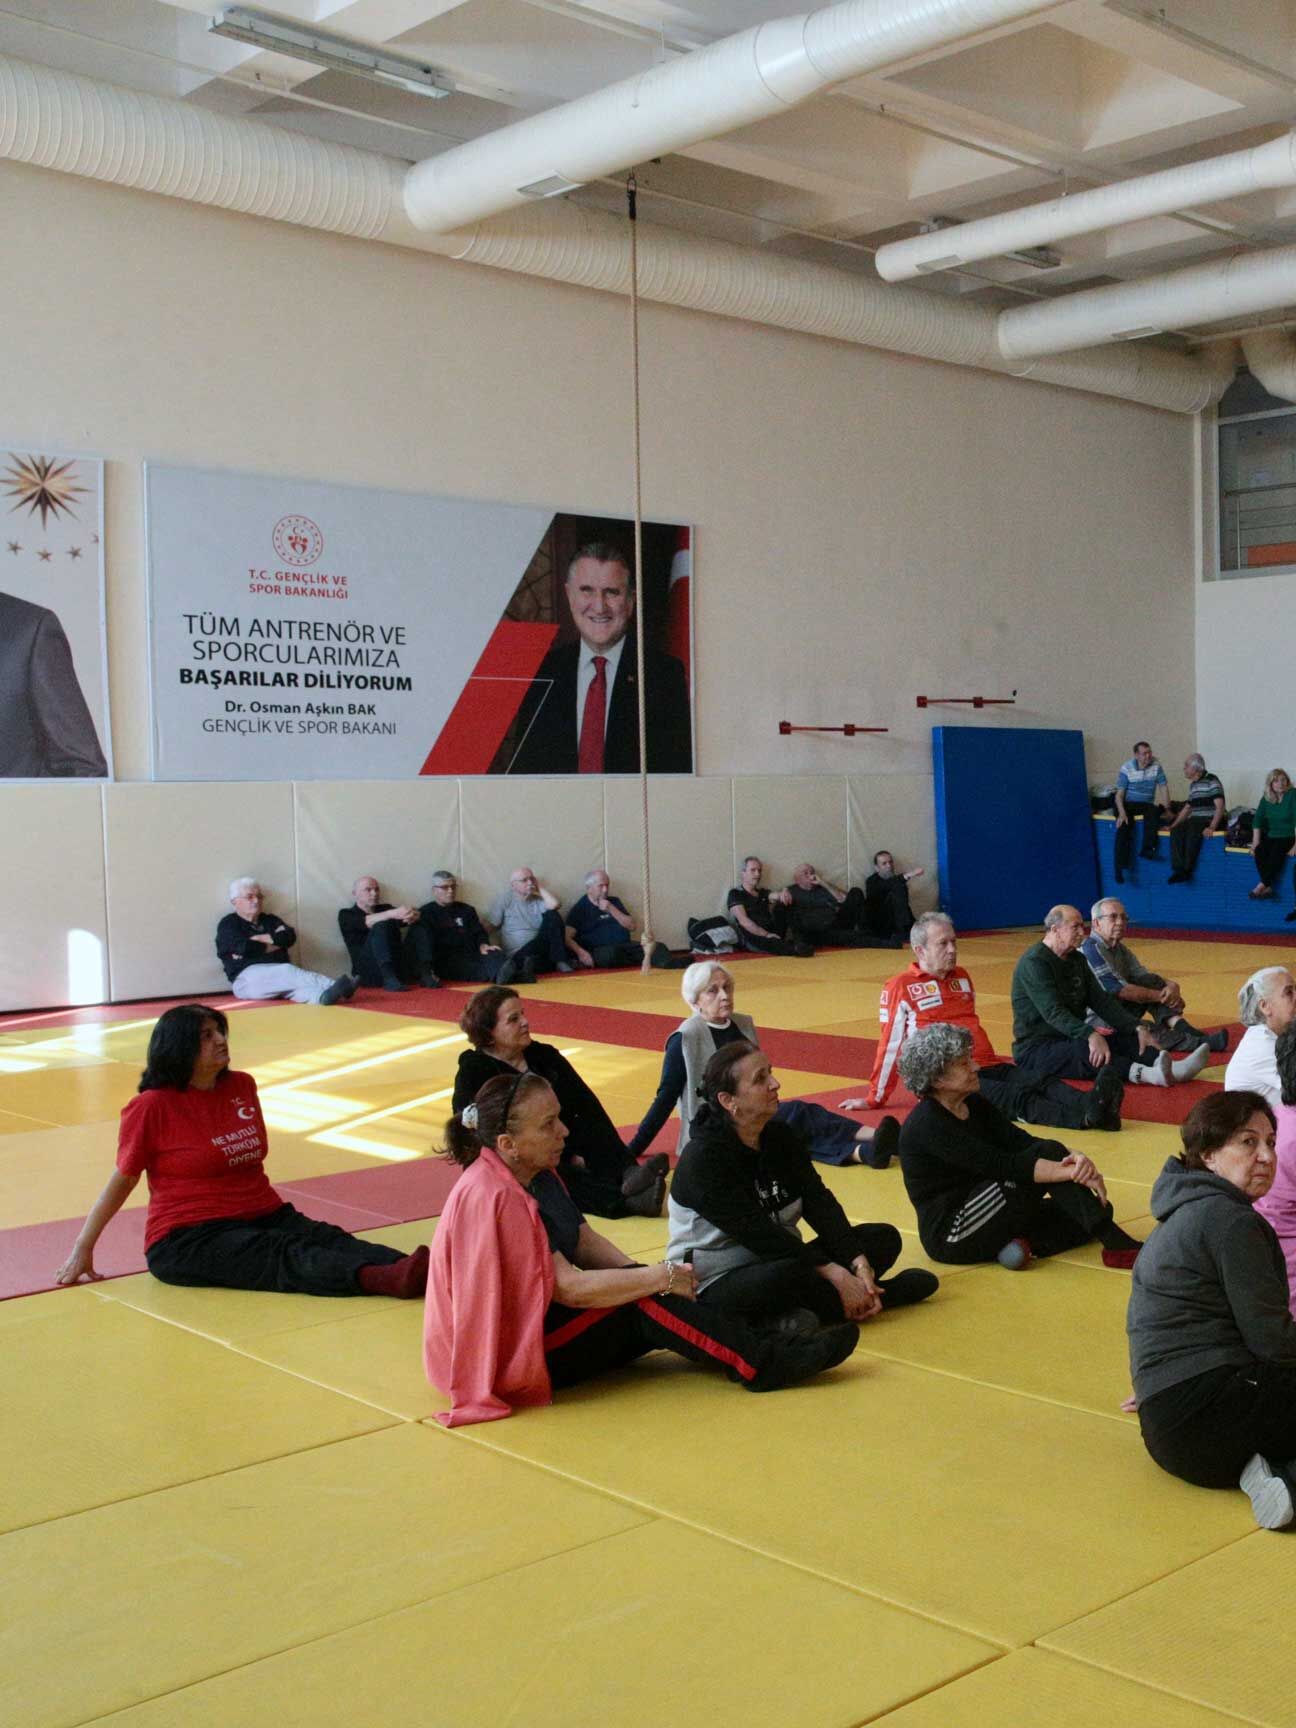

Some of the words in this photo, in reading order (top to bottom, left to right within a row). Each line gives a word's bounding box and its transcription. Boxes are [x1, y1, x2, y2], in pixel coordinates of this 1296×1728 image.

[248, 569, 271, 580] T.C.
[275, 570, 328, 586] GENÇLİK
[333, 576, 348, 586] VE
[249, 583, 281, 595] SPOR
[285, 585, 348, 599] BAKANLIĞI
[183, 612, 240, 637] TÜM
[248, 618, 374, 643] ANTRENÖR
[380, 626, 407, 645] VE
[193, 640, 400, 668] SPORCULARIMIZA
[180, 669, 298, 689] BAŞARILAR
[304, 672, 412, 691] DİLİYORUM
[225, 701, 246, 713] Dr.
[250, 702, 301, 714] Osman
[306, 702, 345, 715] Aşkın
[348, 703, 376, 715] BAK
[203, 718, 271, 735] GENÇLİK
[276, 721, 294, 734] VE
[298, 721, 337, 734] SPOR
[342, 722, 396, 735] BAKANI
[211, 1135, 227, 1146] NE
[225, 1125, 257, 1142] MUTLU
[221, 1137, 261, 1156] TÜRKÜM
